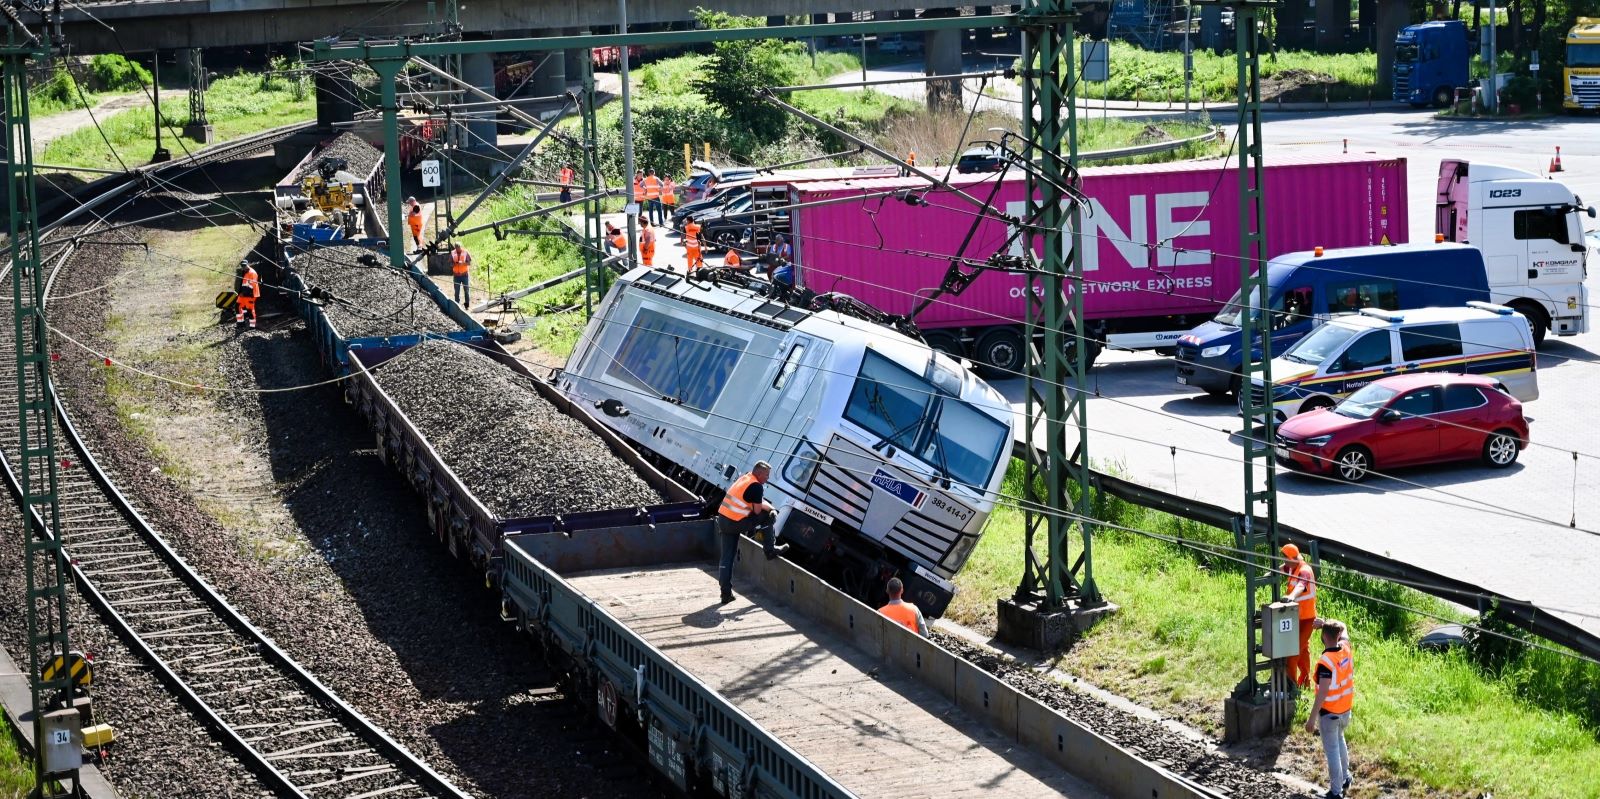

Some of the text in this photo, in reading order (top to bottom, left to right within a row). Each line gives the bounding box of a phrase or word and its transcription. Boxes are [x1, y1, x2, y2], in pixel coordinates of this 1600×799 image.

[422, 166, 439, 175] 600
[429, 175, 434, 183] 4
[1489, 188, 1522, 198] 1023
[1068, 280, 1140, 295] NETWORK
[1147, 276, 1213, 291] EXPRESS
[873, 472, 903, 495] HHLA
[804, 505, 828, 522] SIEMENS
[931, 497, 967, 521] 383 414-0
[1281, 620, 1290, 630] 33
[56, 731, 68, 743] 34
